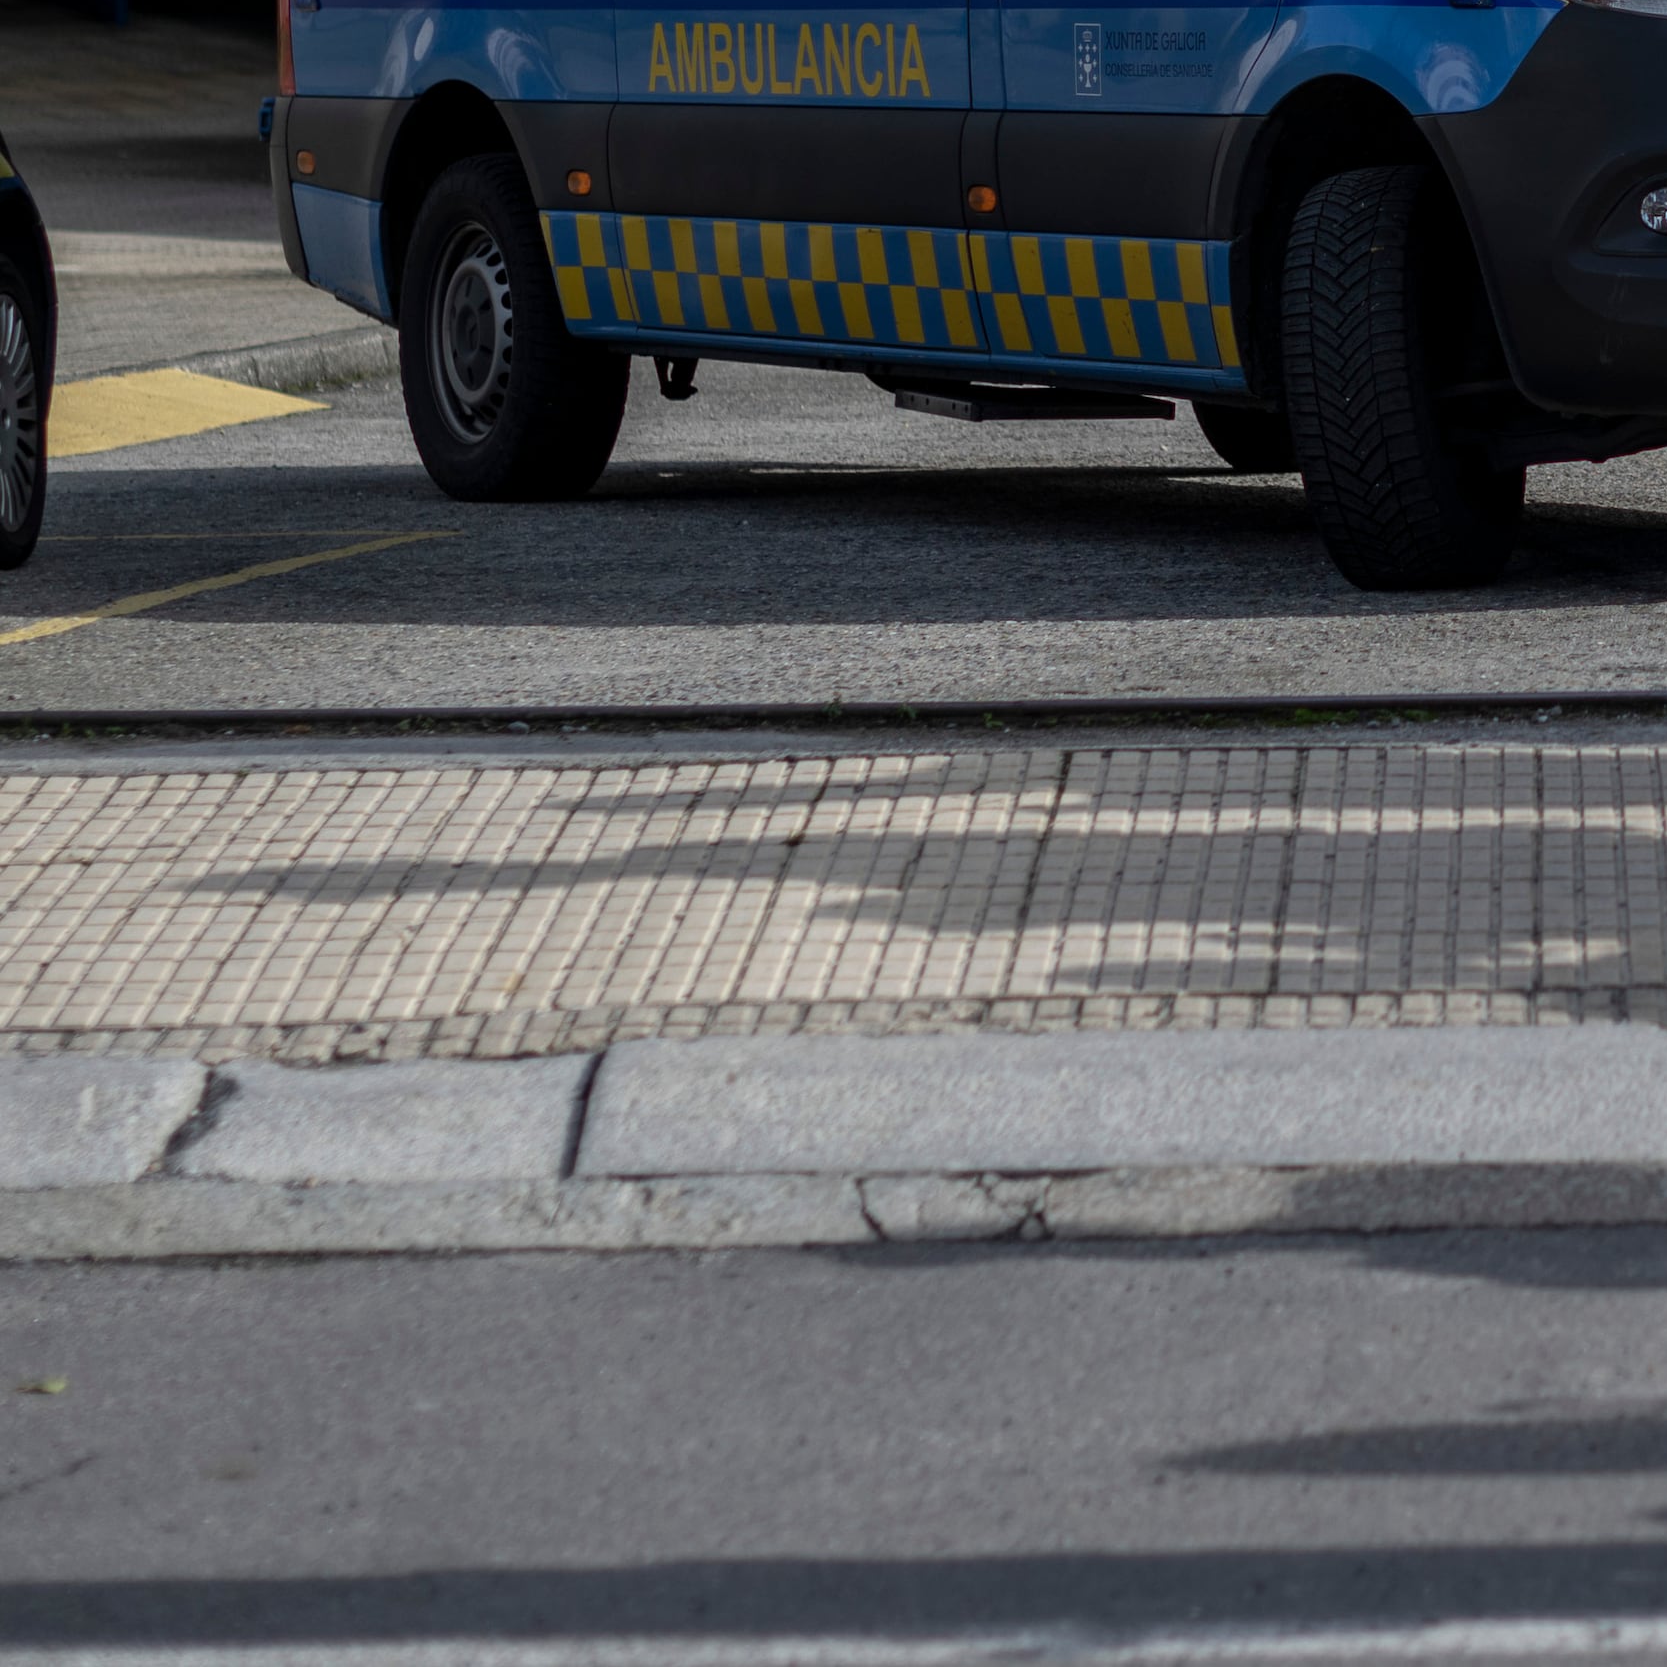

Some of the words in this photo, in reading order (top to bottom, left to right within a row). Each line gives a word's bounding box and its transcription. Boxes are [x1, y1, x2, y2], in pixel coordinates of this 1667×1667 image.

[1105, 31, 1143, 51] XUNTA
[1145, 31, 1159, 51] DE
[1160, 31, 1207, 51] GALICIA
[648, 21, 932, 98] AMBULANCIA
[1160, 63, 1171, 77] DE
[1172, 63, 1214, 78] SANIDADE
